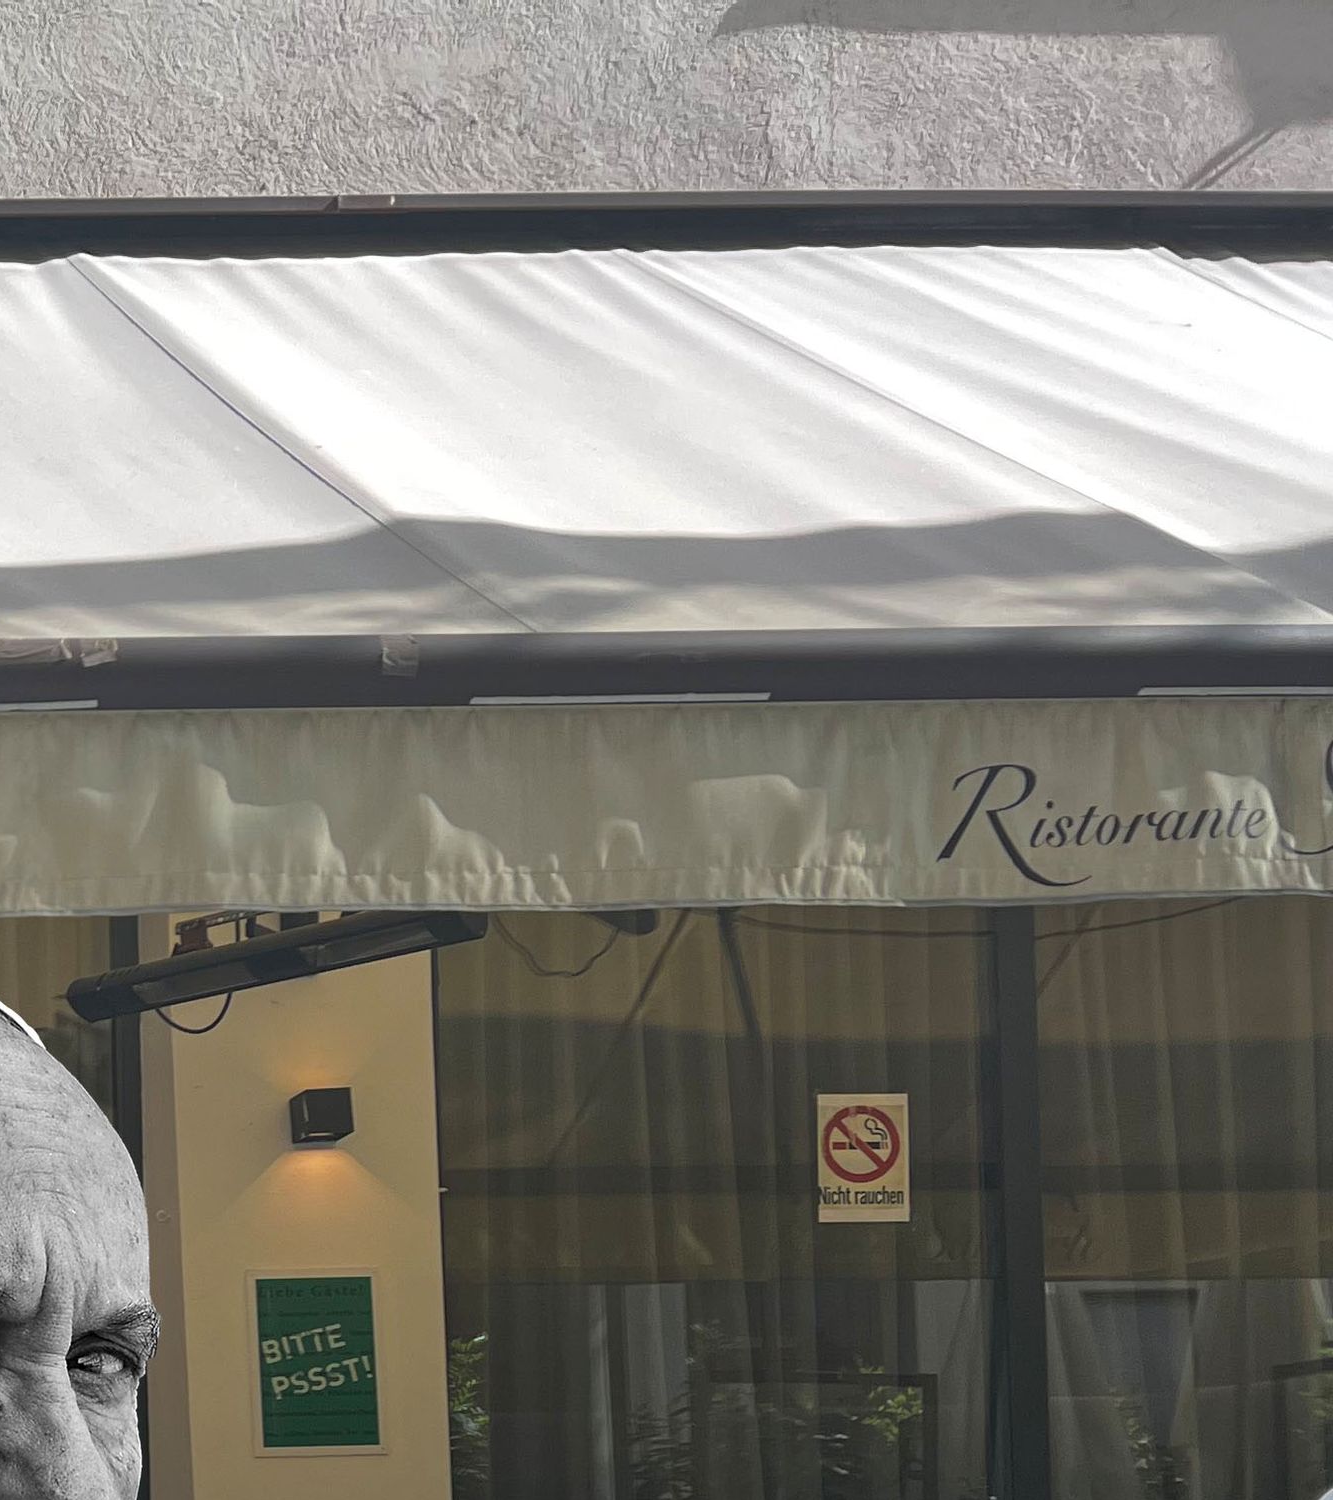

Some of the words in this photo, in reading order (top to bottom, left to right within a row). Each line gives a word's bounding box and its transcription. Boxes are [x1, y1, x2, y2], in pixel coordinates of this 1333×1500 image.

[935, 763, 1276, 887] Ristorante
[820, 1186, 851, 1204] Nicht
[854, 1185, 904, 1205] rauchen
[271, 1355, 374, 1400] PSSST!
